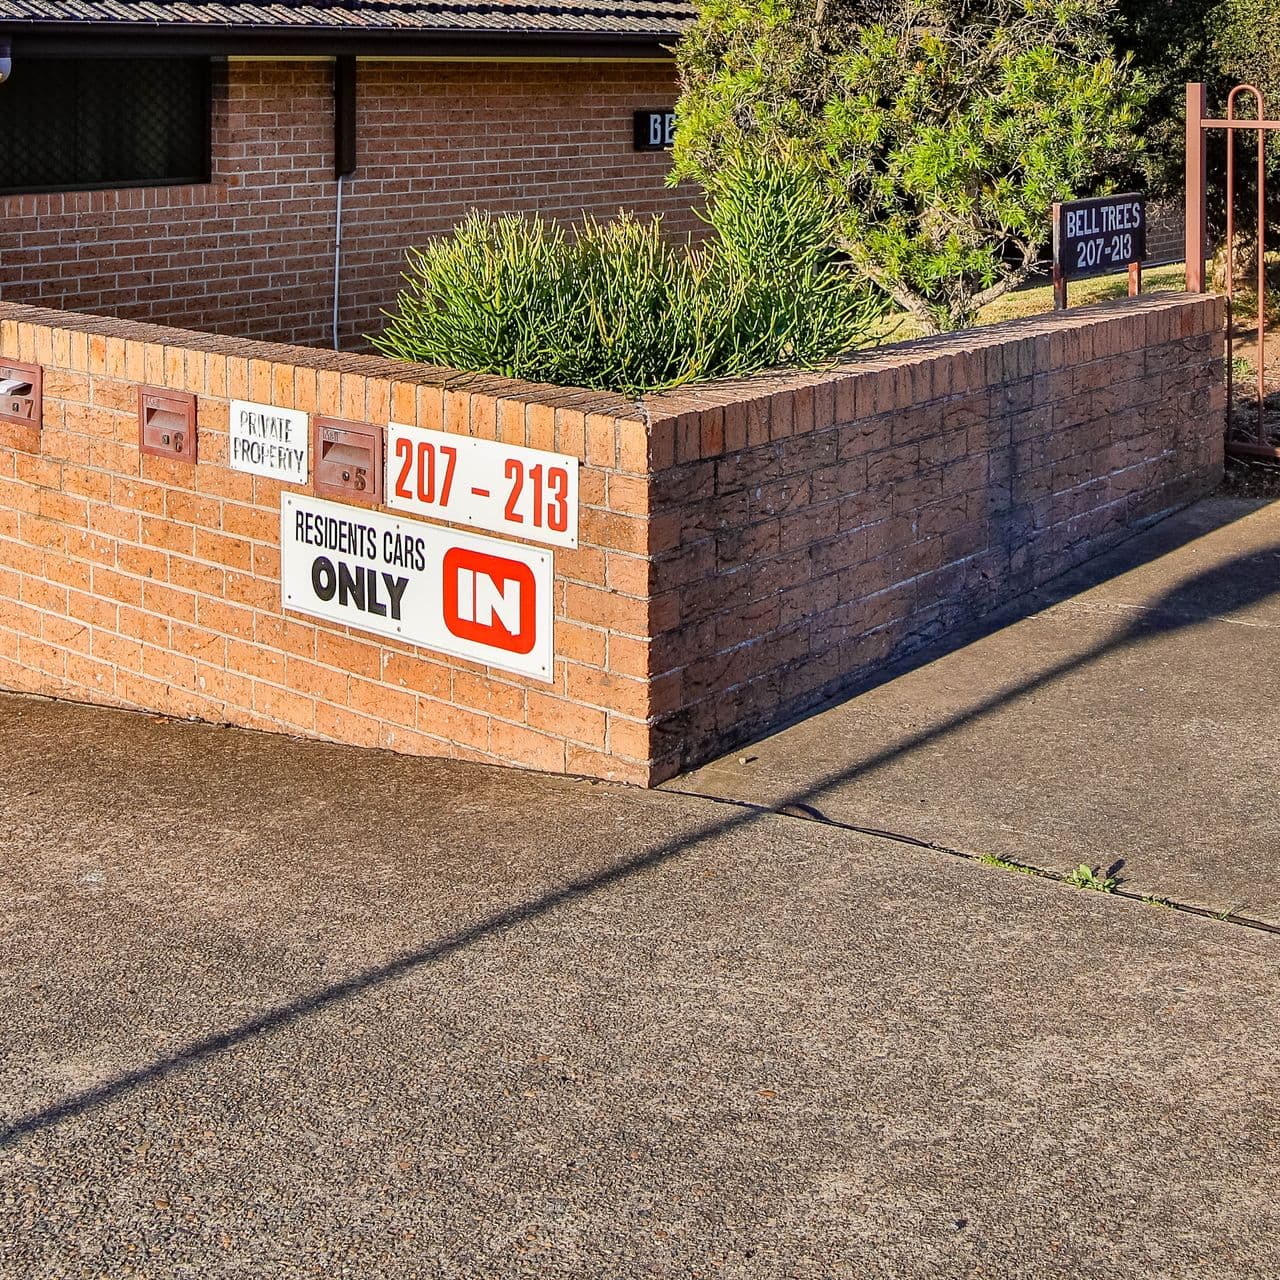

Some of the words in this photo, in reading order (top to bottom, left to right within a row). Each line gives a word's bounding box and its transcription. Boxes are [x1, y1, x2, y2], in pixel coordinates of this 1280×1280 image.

[1066, 208, 1099, 238] BELL
[1101, 202, 1141, 232] TREES
[1077, 233, 1132, 268] 207-213
[25, 399, 34, 418] 7
[240, 410, 293, 443] PRIVATE
[234, 437, 304, 474] PROPERTY
[354, 468, 366, 490] 5
[395, 437, 457, 507] 207
[504, 458, 568, 532] 213
[295, 510, 377, 560] RESIDENTS
[383, 532, 426, 572] CARS
[311, 555, 409, 620] ONLY
[457, 567, 520, 636] IN
